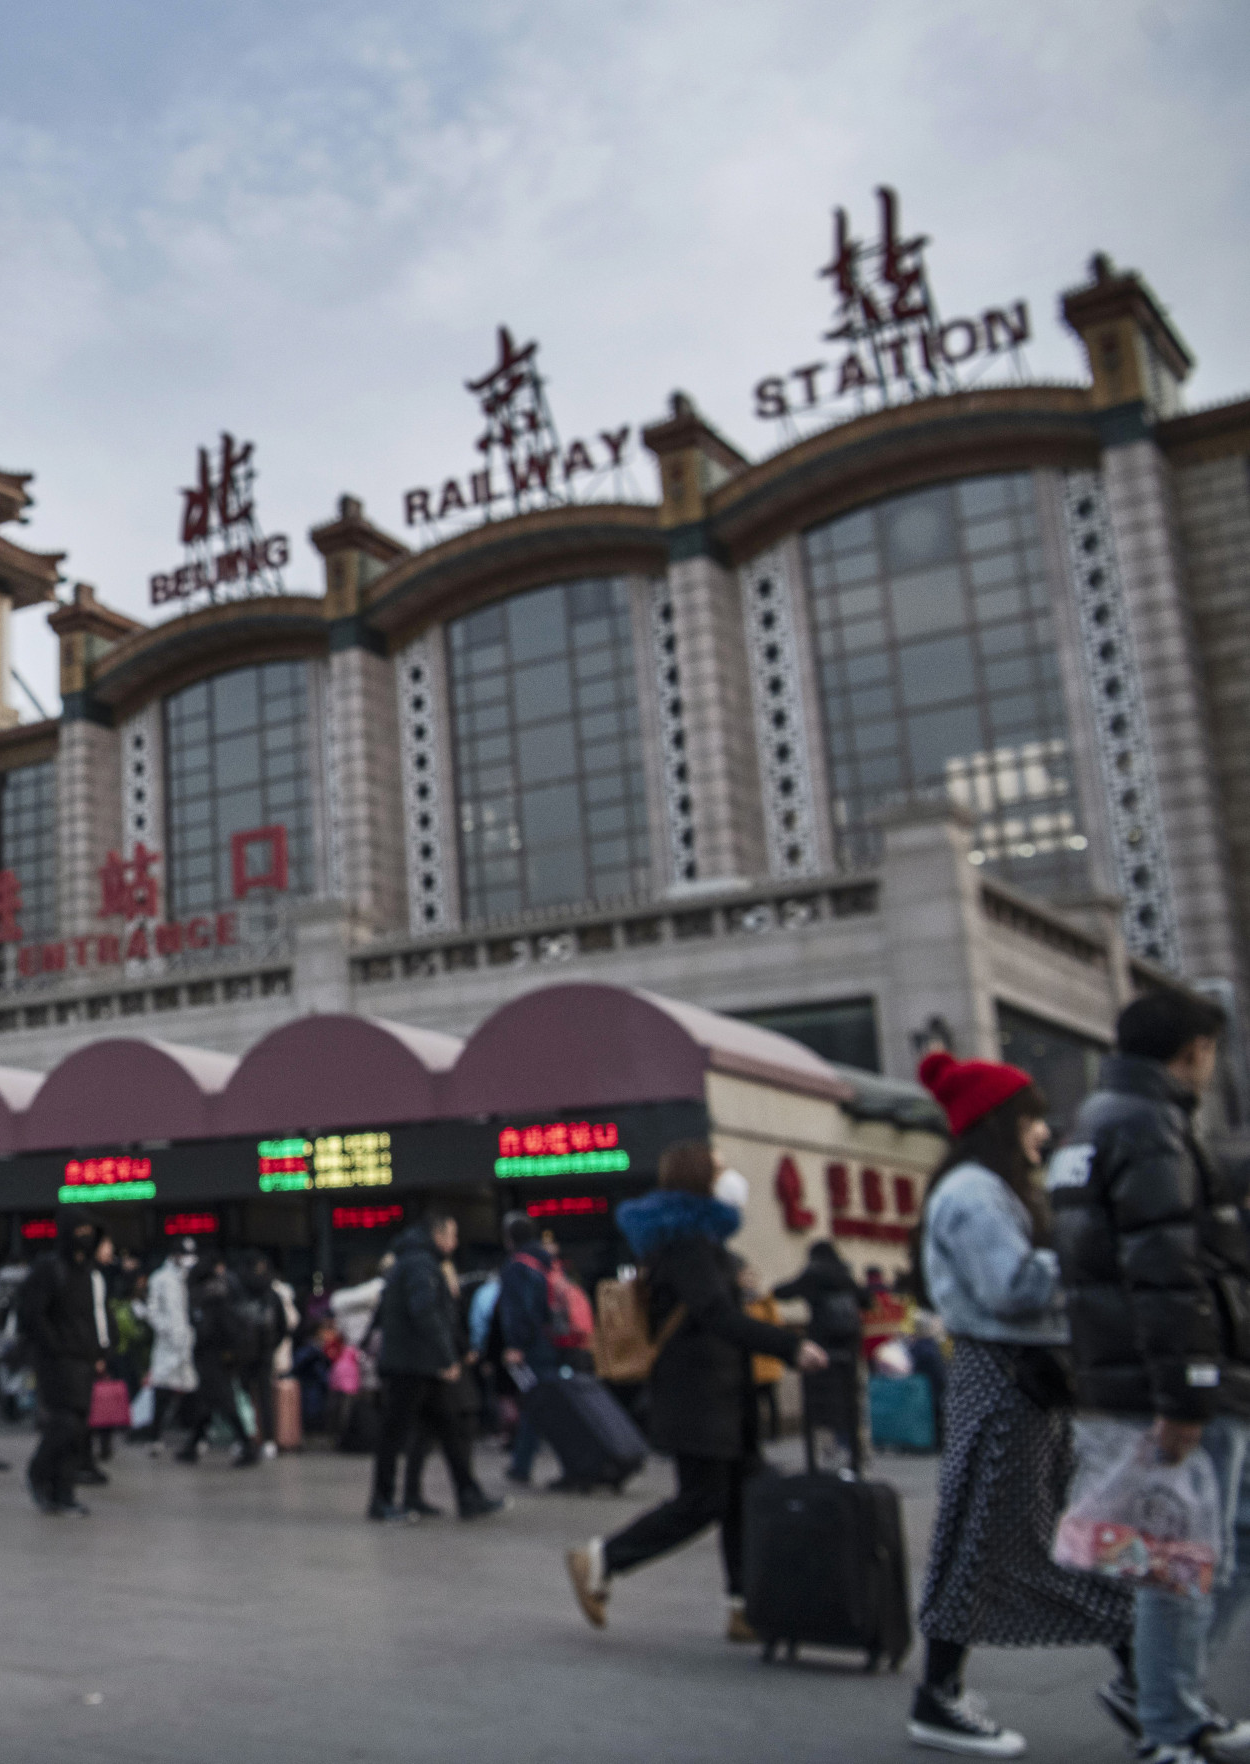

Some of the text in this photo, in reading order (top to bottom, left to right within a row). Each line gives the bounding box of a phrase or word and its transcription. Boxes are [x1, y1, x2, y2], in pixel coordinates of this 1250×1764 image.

[149, 301, 1032, 606] BEIJING RAILWAY STATION
[17, 911, 238, 977] ENTRANCE
